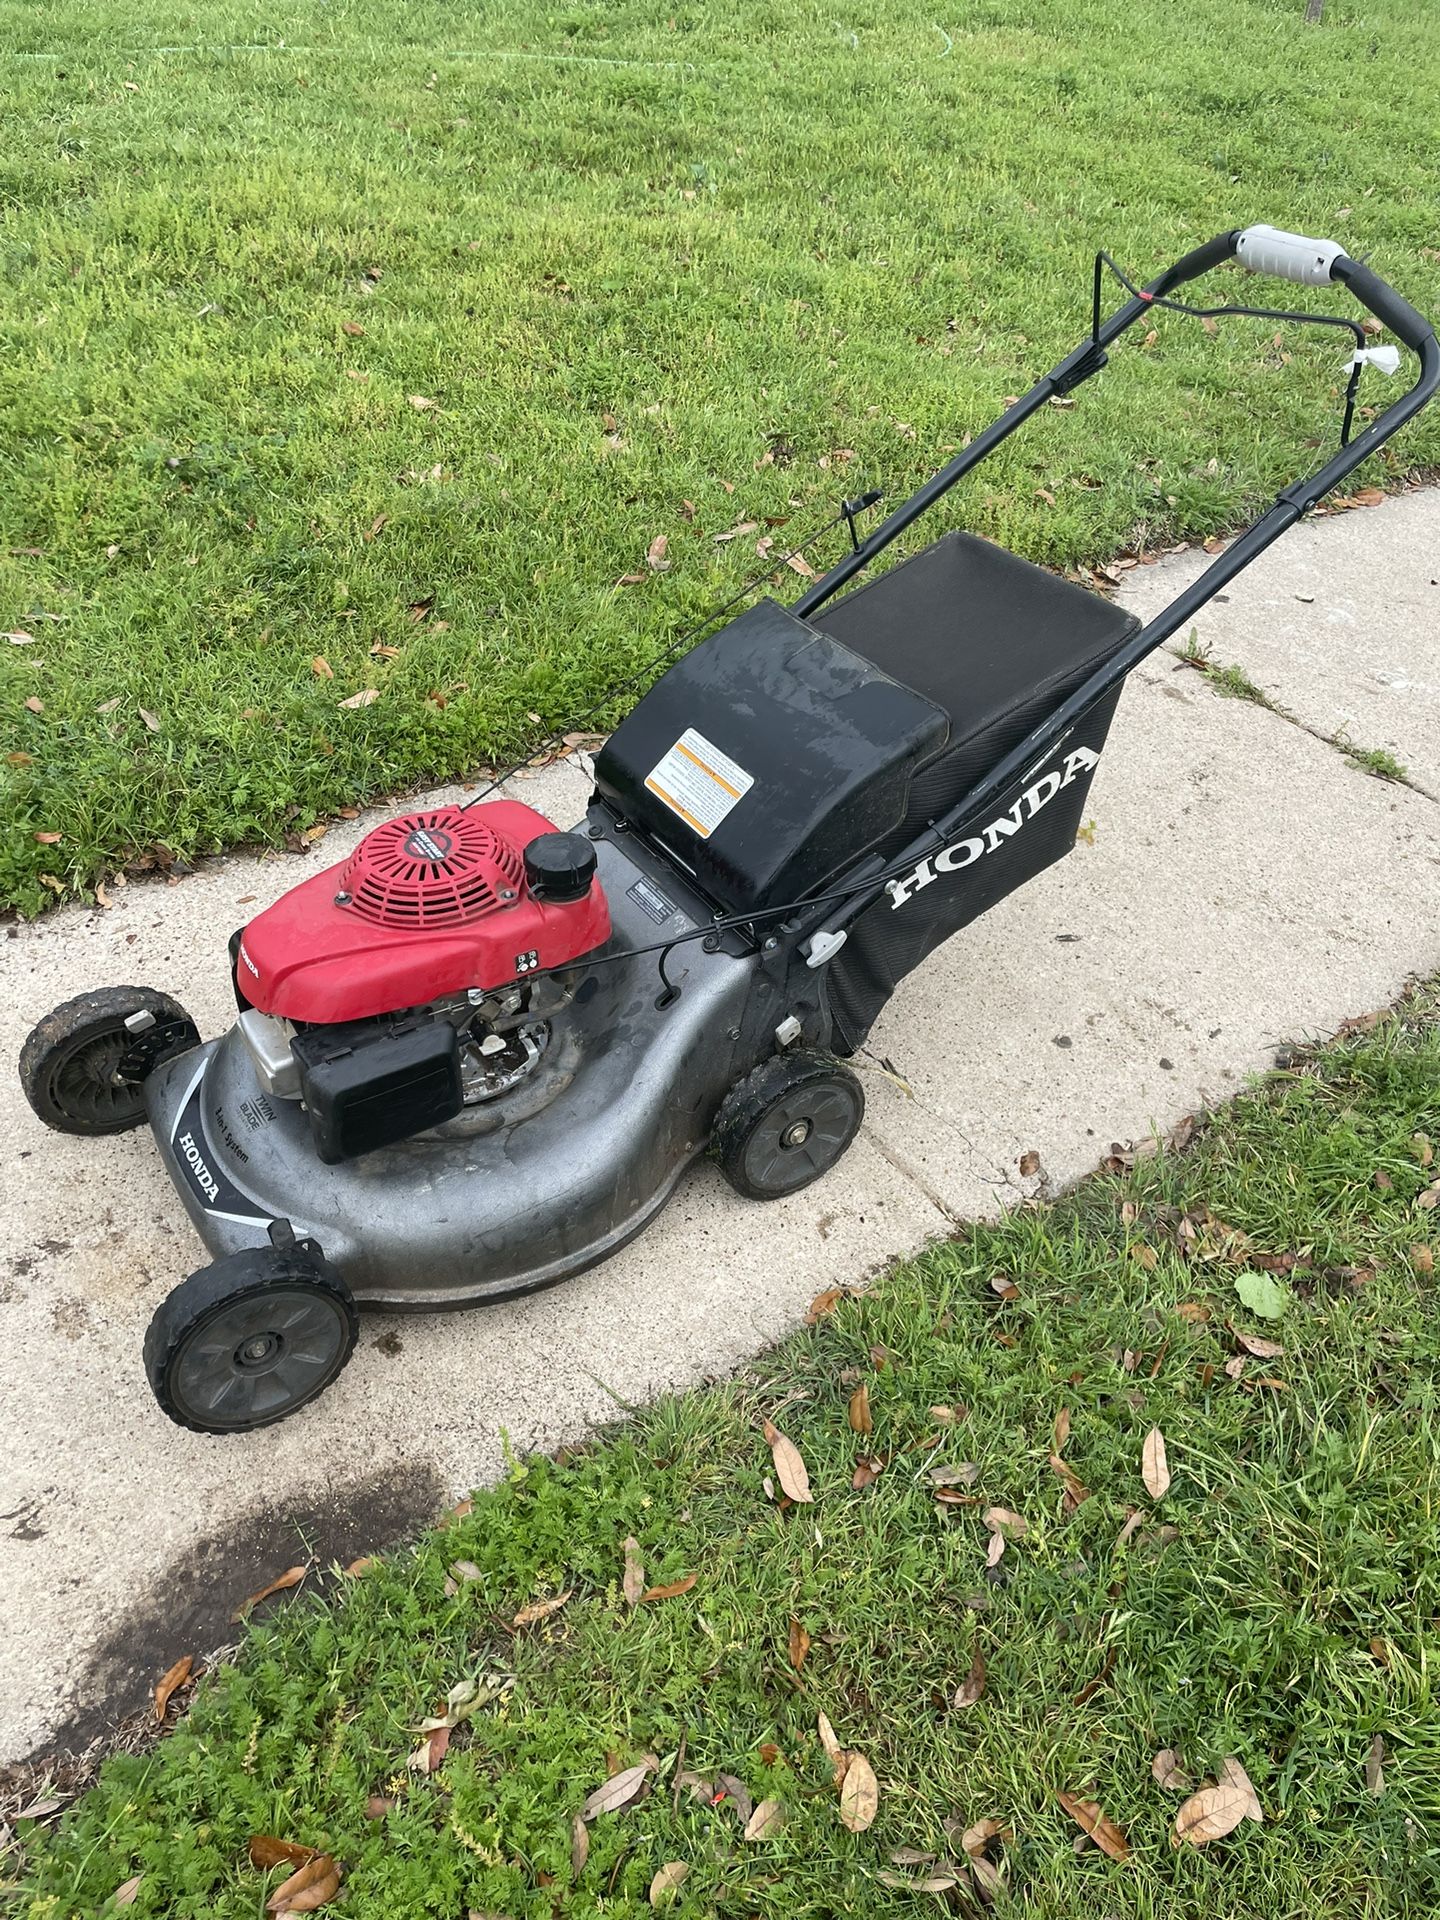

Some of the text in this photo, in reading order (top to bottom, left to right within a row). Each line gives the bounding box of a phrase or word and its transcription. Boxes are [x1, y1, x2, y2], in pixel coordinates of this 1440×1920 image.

[891, 746, 1101, 910] HONDA
[240, 1103, 260, 1130] BLADE
[255, 1094, 277, 1122] TWIN
[225, 1132, 249, 1164] System
[179, 1132, 220, 1204] HONDA
